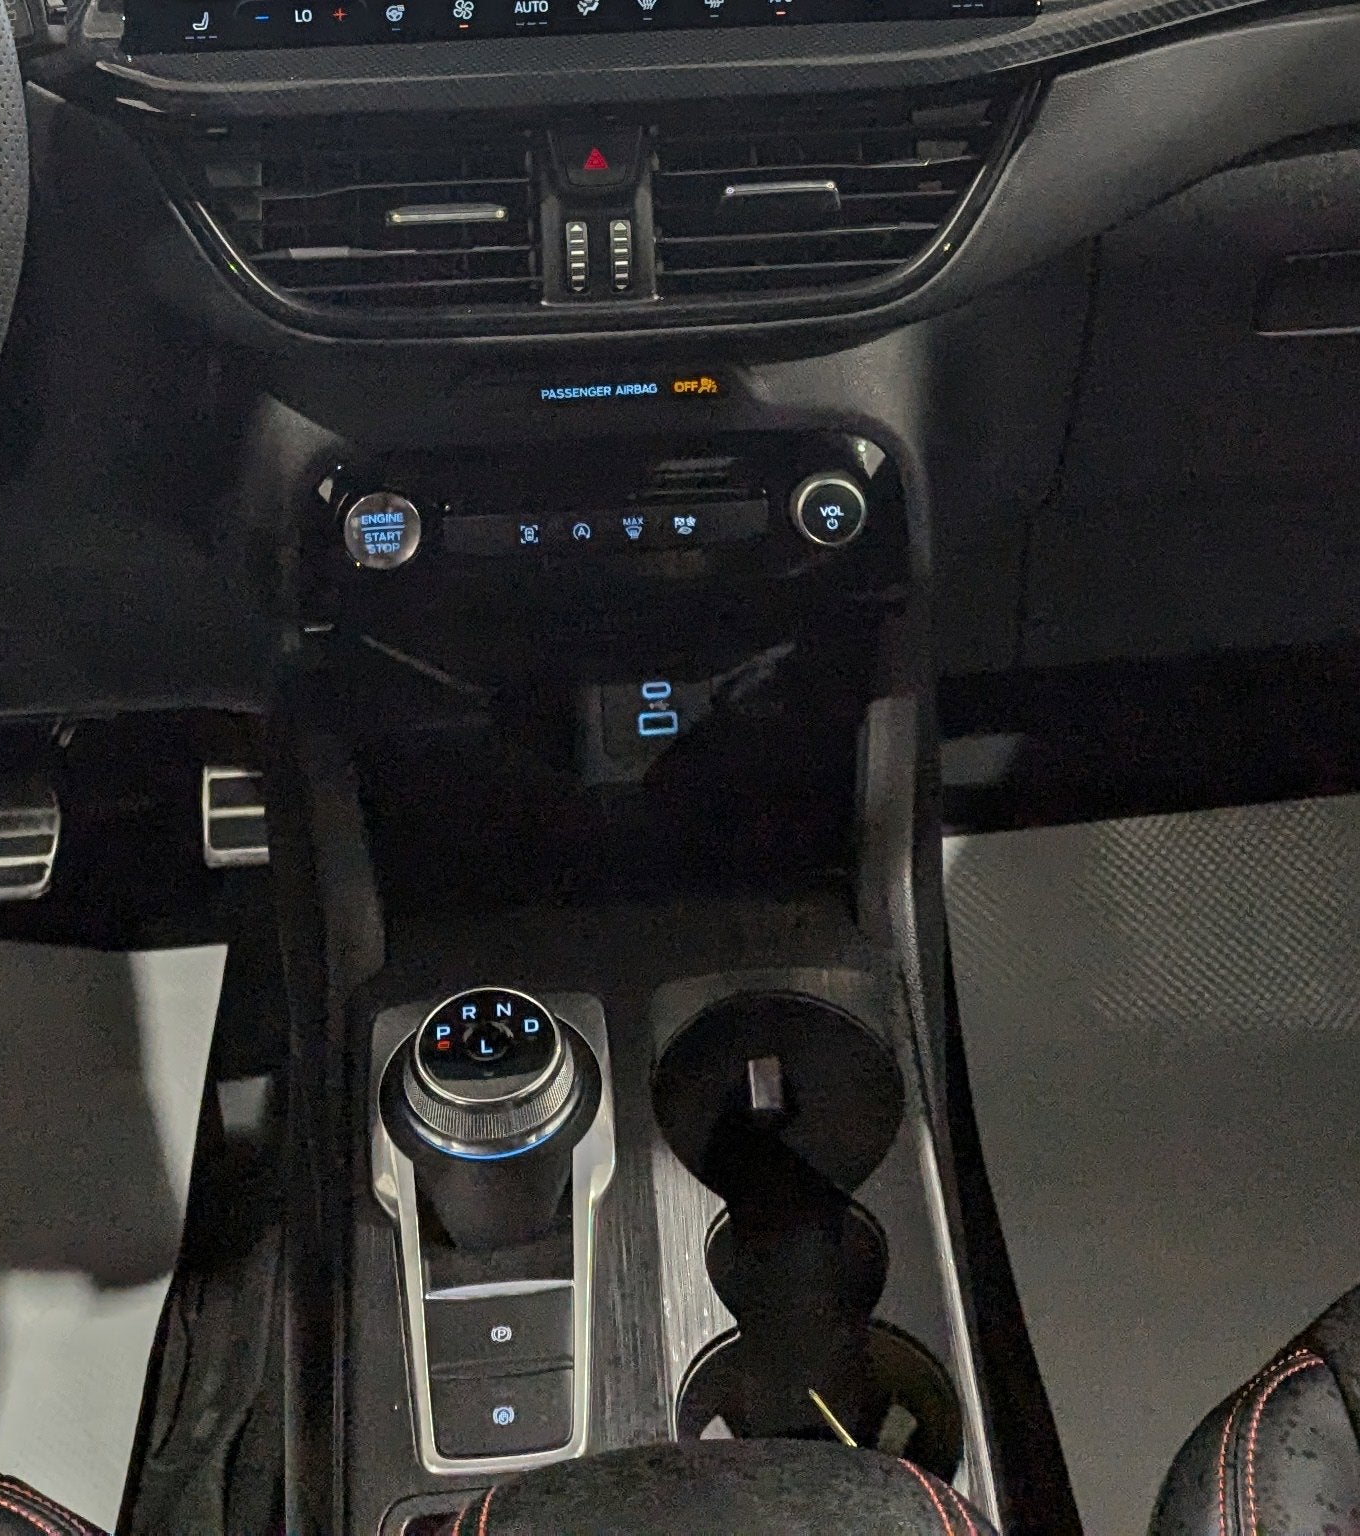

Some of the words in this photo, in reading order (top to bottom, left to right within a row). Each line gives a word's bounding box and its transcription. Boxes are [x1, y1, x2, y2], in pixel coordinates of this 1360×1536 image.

[513, 0, 549, 15] AUTO
[294, 9, 313, 24] LO
[541, 385, 612, 400] PASSENGER
[615, 383, 658, 397] AIRBAG
[674, 381, 698, 393] OFF
[361, 511, 404, 525] ENGINE
[819, 505, 845, 517] VOL
[623, 517, 644, 526] MAX
[364, 530, 403, 544] START
[366, 543, 401, 555] STOP
[462, 1005, 477, 1020] R
[496, 1002, 512, 1017] N
[436, 1026, 451, 1041] P
[524, 1019, 539, 1033] D
[480, 1038, 494, 1054] L
